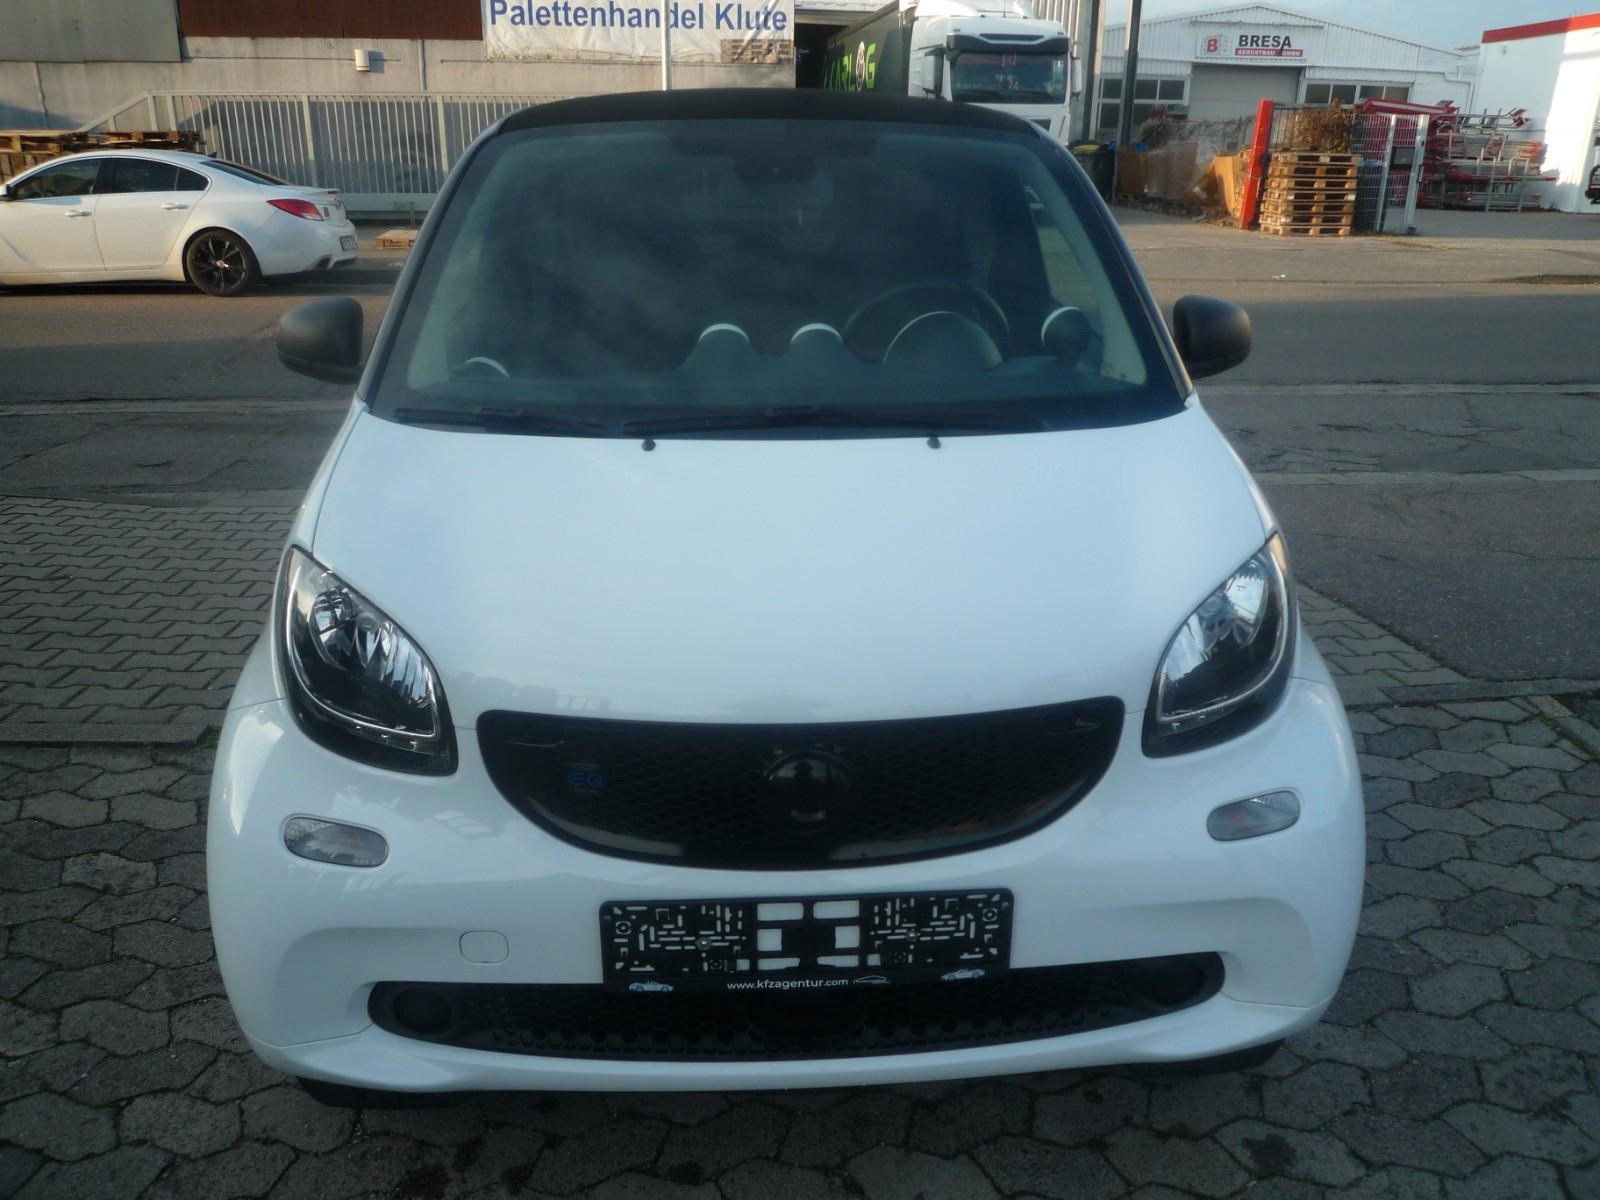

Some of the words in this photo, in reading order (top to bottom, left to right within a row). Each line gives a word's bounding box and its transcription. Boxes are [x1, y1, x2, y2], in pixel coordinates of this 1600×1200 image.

[490, 1, 705, 29] Palettenhandel
[715, 3, 788, 31] Klute
[1207, 38, 1218, 52] B
[1238, 34, 1292, 51] BRESA
[568, 772, 603, 788] EQ
[726, 978, 849, 991] www.kfzagentur.com
